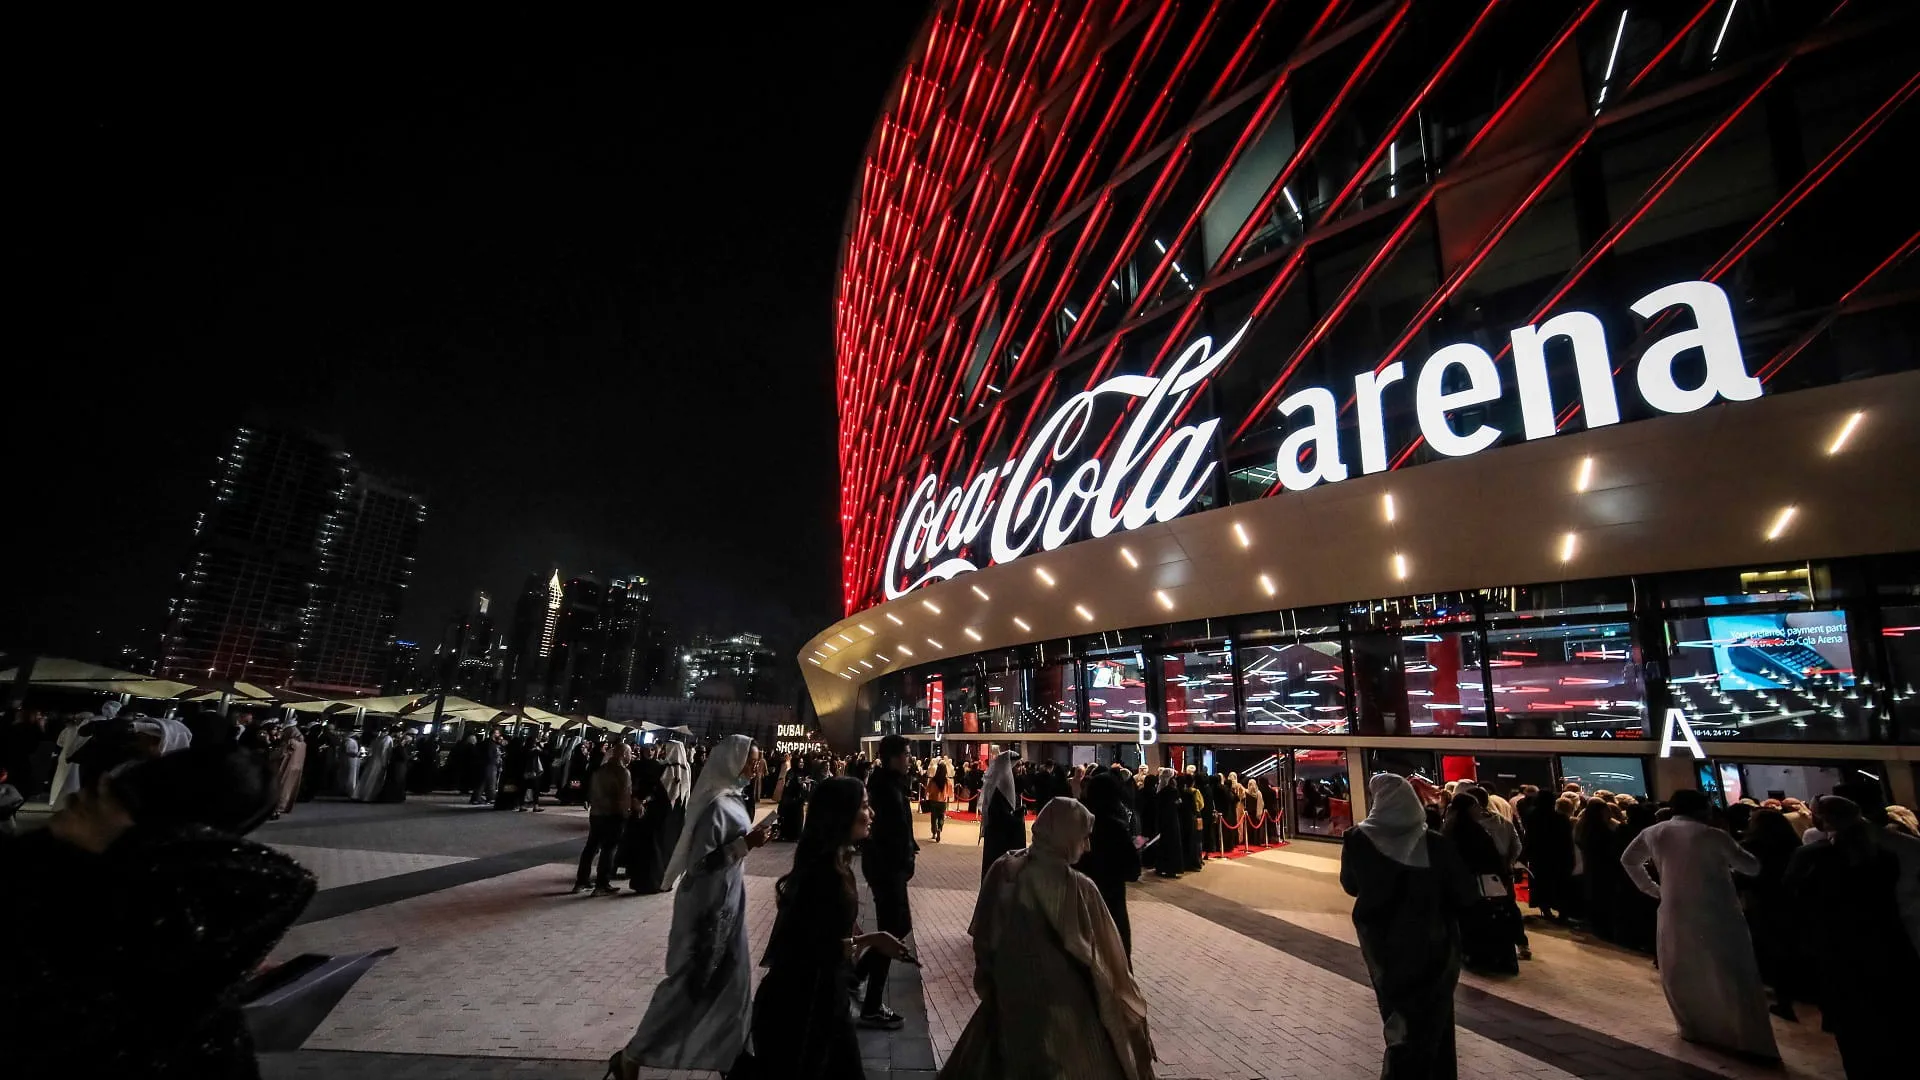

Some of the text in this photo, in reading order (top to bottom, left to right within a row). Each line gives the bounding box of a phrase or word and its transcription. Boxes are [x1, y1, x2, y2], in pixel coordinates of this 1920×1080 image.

[884, 280, 1763, 601] Coca-Cola arena
[1750, 627, 1786, 639] preferred
[1787, 625, 1824, 637] payment
[1774, 636, 1816, 647] Coca-Cola
[1817, 635, 1843, 645] Arena
[777, 724, 804, 737] DUBAI
[1138, 712, 1158, 745] B
[1660, 708, 1706, 759] A
[776, 740, 821, 754] SHOPPING
